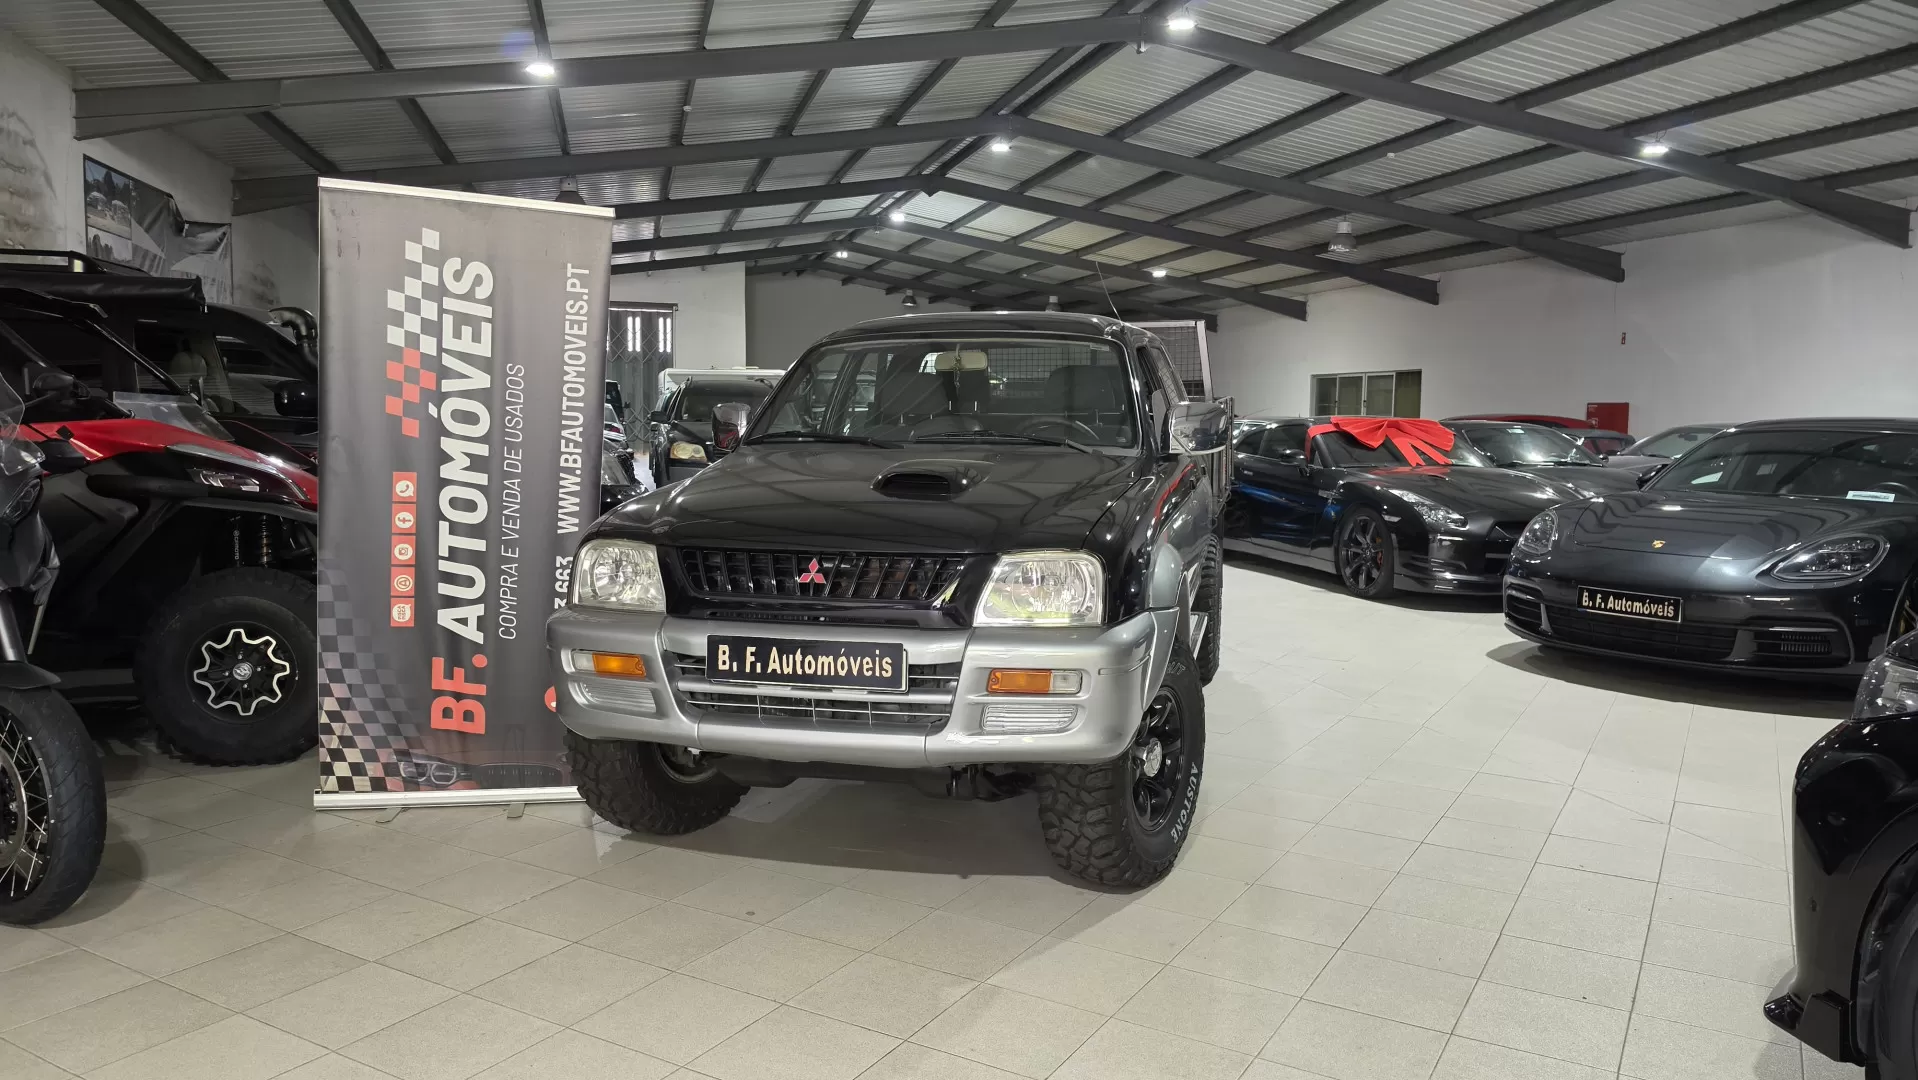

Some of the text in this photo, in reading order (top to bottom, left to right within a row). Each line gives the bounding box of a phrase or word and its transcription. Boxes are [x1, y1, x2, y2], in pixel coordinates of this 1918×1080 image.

[557, 263, 590, 534] WWW.BFAUTOMOVEIS.PT
[428, 257, 494, 735] BF. AUTOMÓVEIS
[498, 363, 525, 640] COMPRA E VENDA DE USADOS
[555, 555, 574, 593] 663
[1582, 591, 1675, 618] B. F. Automóveis
[717, 644, 893, 678] B. F. Automóveis
[1170, 761, 1199, 844] AUSTONE
